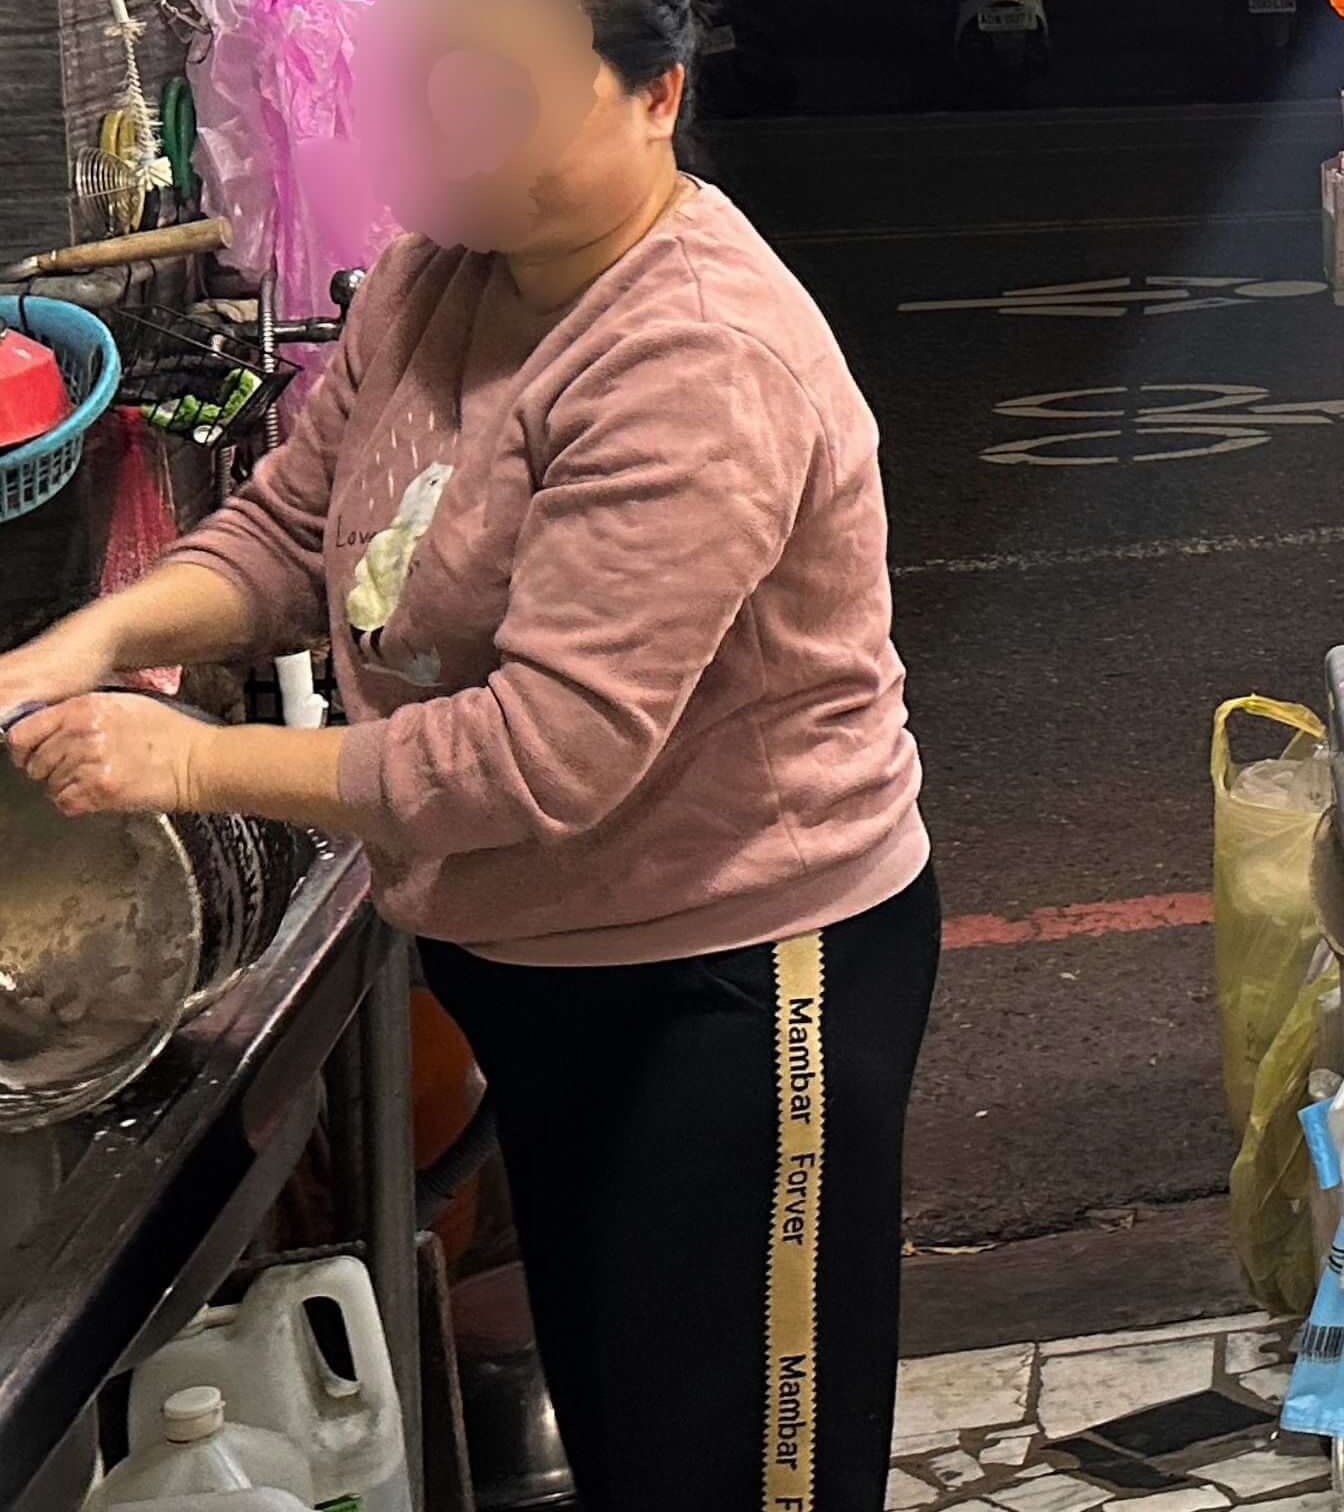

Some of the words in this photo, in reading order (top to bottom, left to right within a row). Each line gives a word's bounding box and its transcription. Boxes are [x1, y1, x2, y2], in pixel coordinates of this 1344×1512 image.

[335, 514, 380, 548] Lov
[788, 997, 815, 1125] Mambar
[782, 1152, 816, 1246] Forver
[773, 1355, 806, 1471] Mambar
